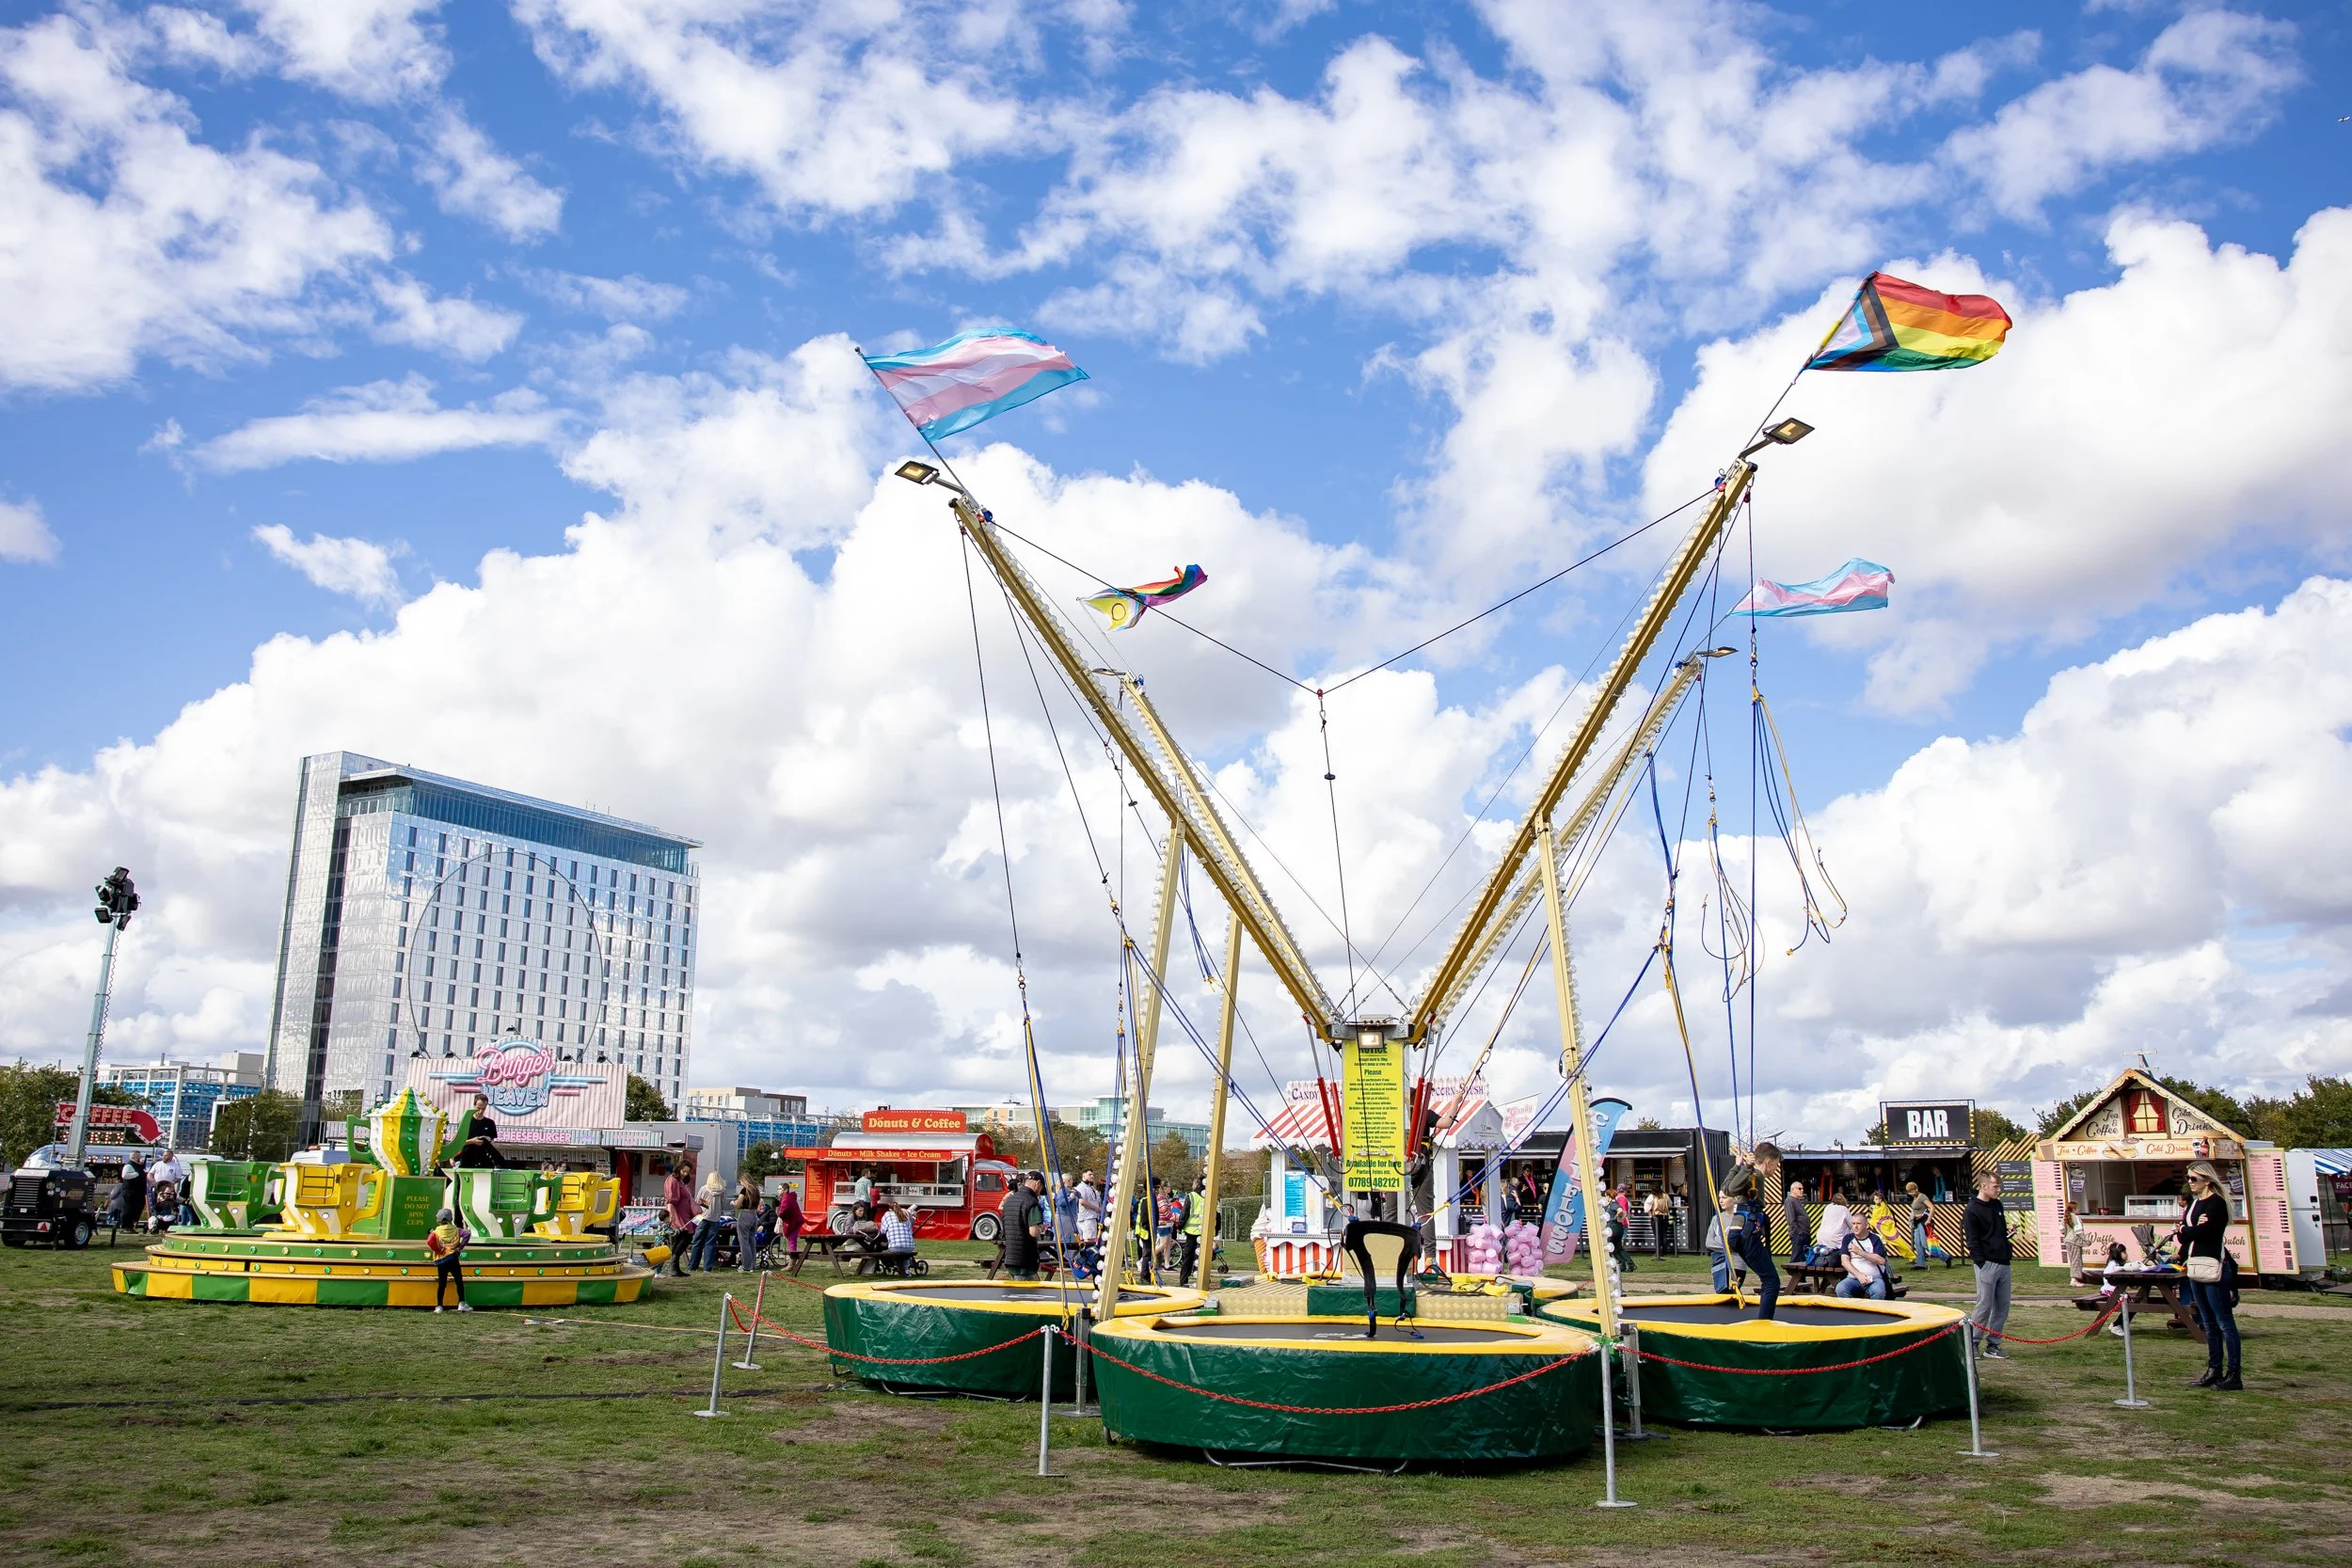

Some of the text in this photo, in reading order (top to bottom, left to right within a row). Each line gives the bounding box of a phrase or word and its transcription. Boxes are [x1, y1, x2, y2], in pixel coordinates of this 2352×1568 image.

[476, 1048, 553, 1086] Burger
[483, 1085, 549, 1107] HEAVEN
[1292, 1088, 1319, 1100] CANDY
[60, 1106, 133, 1124] CFFEE
[2103, 1108, 2119, 1121] Tea
[924, 1117, 961, 1129] Coffee
[1907, 1110, 1949, 1138] BAR
[2086, 1121, 2118, 1138] Coffee
[859, 1149, 875, 1158] Milk
[876, 1149, 899, 1159] Shakes
[2057, 1144, 2098, 1156] Tea Coffee
[2146, 1143, 2193, 1155] Cold Drinks
[1377, 1159, 1387, 1167] for
[1373, 1177, 1400, 1187] 482121
